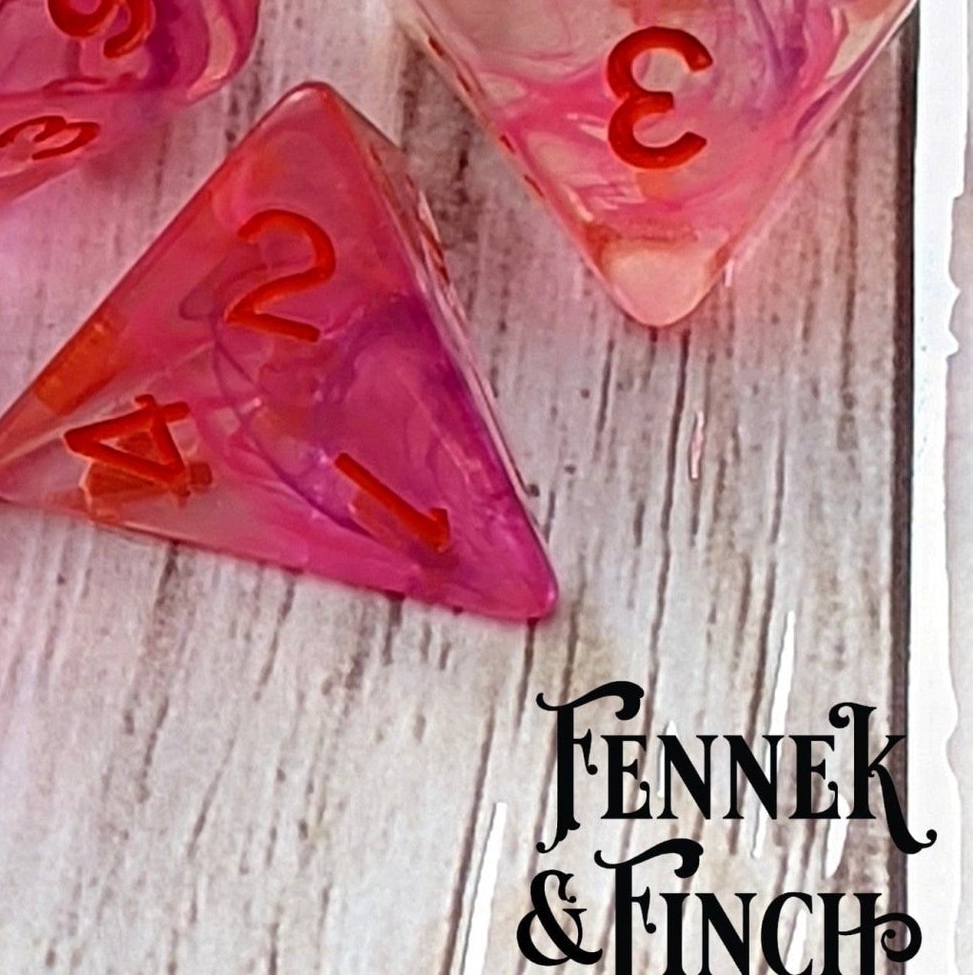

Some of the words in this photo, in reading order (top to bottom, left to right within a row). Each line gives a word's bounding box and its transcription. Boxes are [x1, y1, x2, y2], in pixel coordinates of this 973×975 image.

[607, 26, 714, 170] 3
[224, 209, 335, 343] 2
[63, 393, 190, 496] 4
